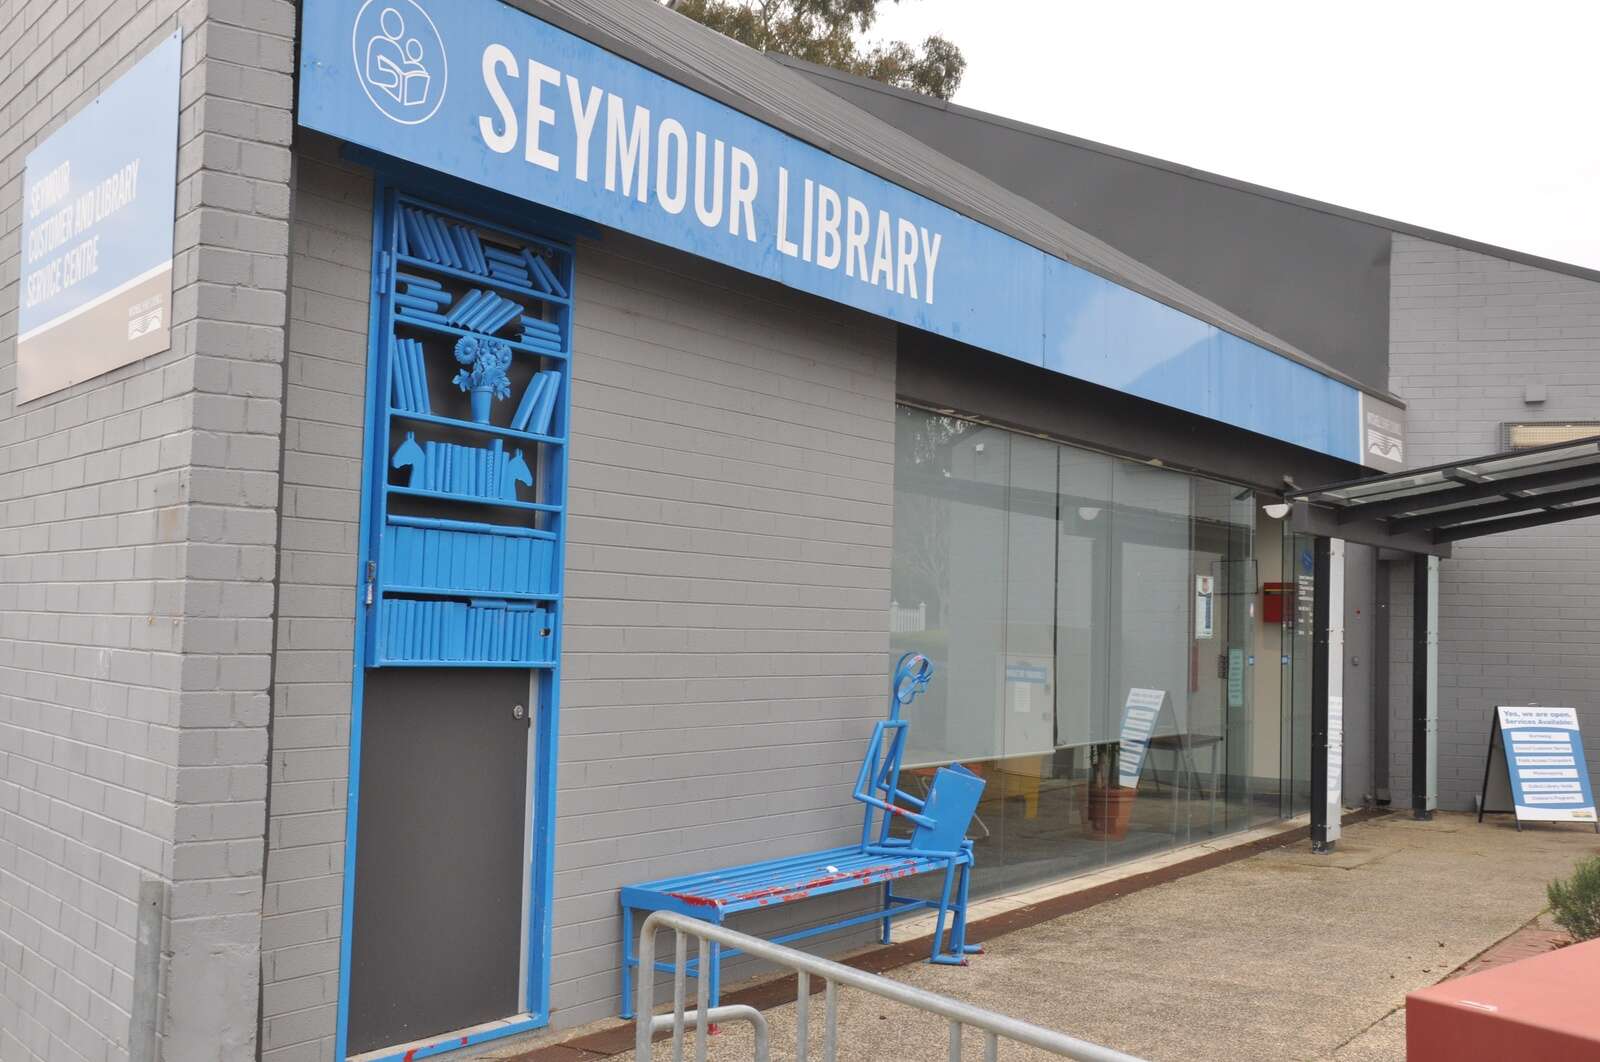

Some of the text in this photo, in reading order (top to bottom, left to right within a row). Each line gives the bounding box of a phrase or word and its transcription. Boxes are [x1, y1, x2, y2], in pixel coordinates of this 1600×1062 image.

[28, 158, 141, 264] CUSTOMER AND LIBRARY
[478, 43, 942, 304] SEYMOUR LIBRARY
[27, 234, 99, 308] SERVICE CENTRE
[1503, 710, 1520, 718] Yes,
